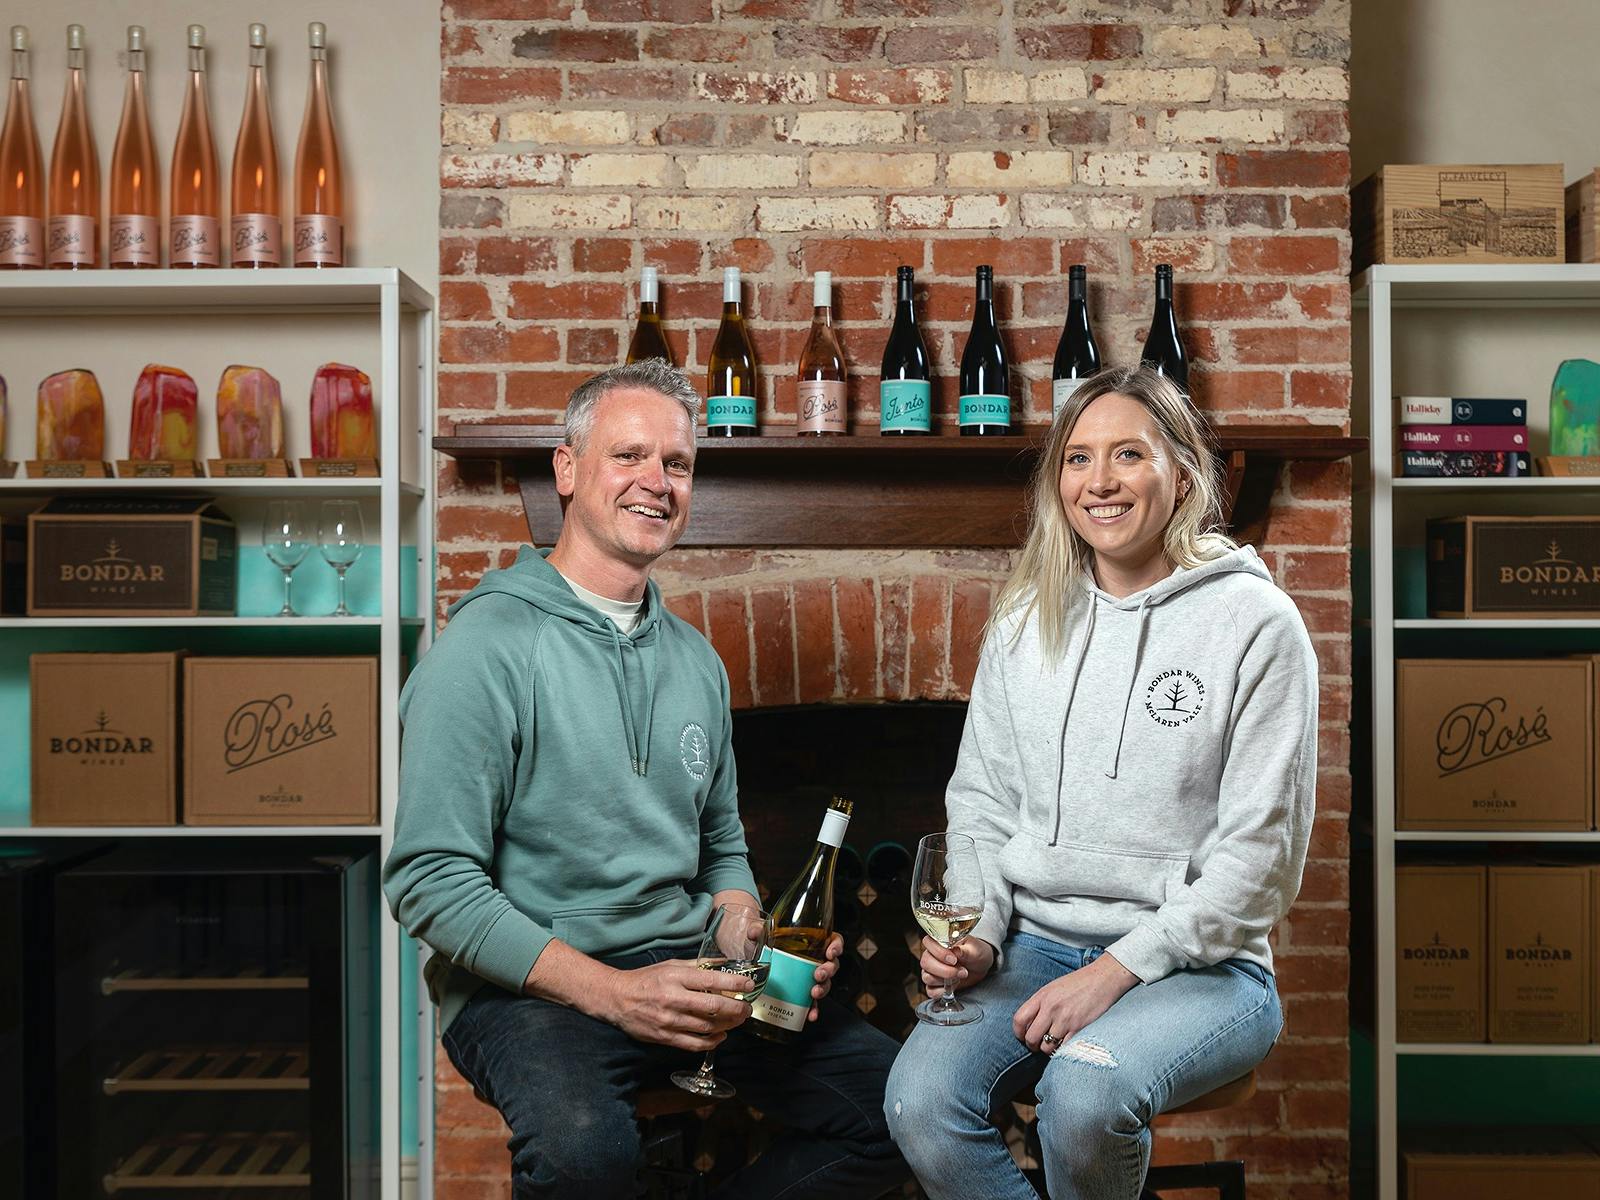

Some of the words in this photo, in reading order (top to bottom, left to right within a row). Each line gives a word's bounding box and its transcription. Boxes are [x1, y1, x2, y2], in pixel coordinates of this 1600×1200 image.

[710, 405, 754, 415] BONDAR
[886, 393, 925, 421] Junto
[964, 404, 1009, 414] BONDAR
[1406, 404, 1441, 415] Halliday
[1404, 432, 1441, 444] Halliday
[1407, 456, 1443, 468] Halliday
[60, 565, 165, 582] BONDAR
[89, 586, 136, 594] WINES
[1531, 588, 1577, 596] WINES
[1147, 669, 1183, 693] BONDAR
[1185, 670, 1205, 695] WINES
[1183, 704, 1202, 724] VALE
[224, 694, 337, 774] Rosé
[1437, 697, 1552, 778] Rosé
[50, 738, 154, 754] BONDAR
[80, 758, 126, 766] WINES
[258, 794, 303, 803] BONDAR
[1472, 800, 1517, 808] BONDAR
[1404, 948, 1470, 960] BONDAR
[1506, 948, 1572, 960] BONDAR
